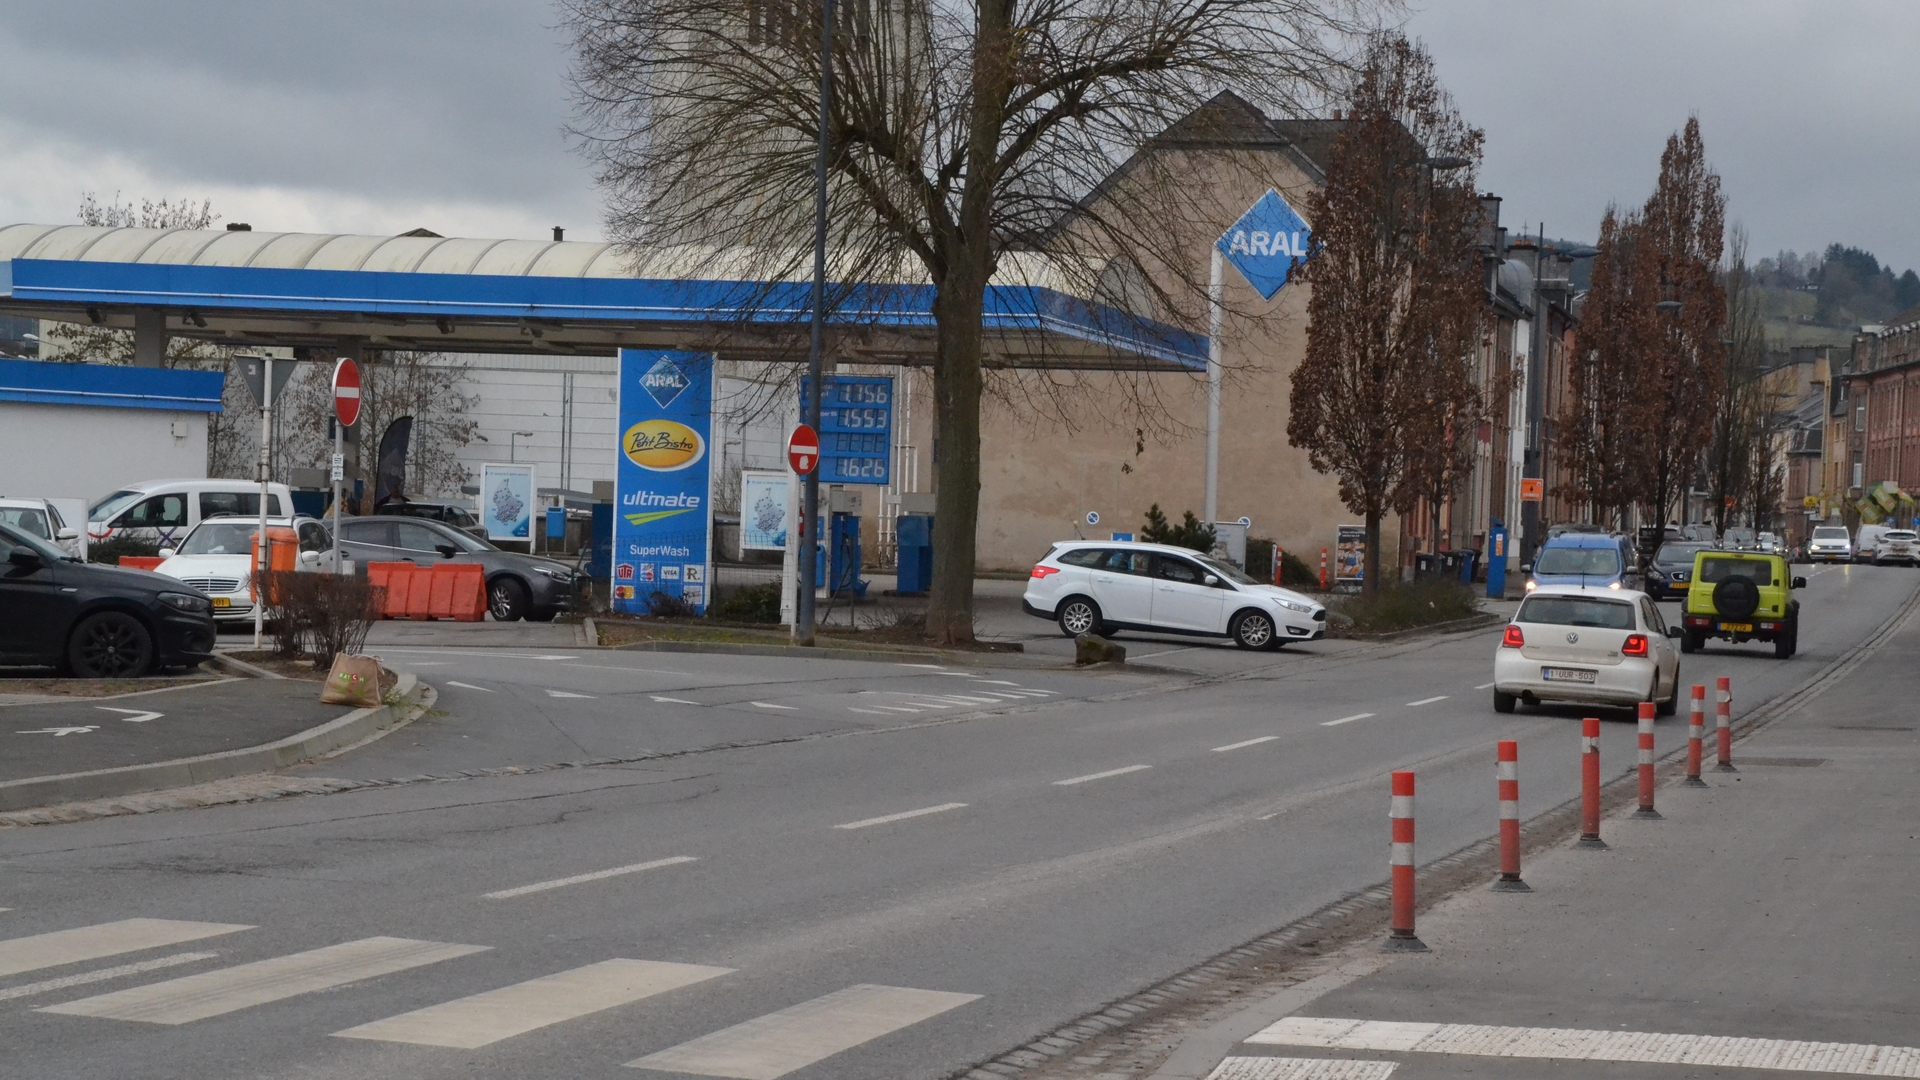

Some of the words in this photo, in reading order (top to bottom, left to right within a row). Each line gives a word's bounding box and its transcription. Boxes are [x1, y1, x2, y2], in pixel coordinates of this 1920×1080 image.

[1228, 230, 1306, 257] ARAL
[645, 374, 683, 388] ARAL
[631, 432, 655, 451] Petit
[654, 432, 694, 450] Bistro
[623, 490, 701, 508] ultimate
[630, 544, 690, 557] SuperWash
[617, 564, 633, 579] UTA
